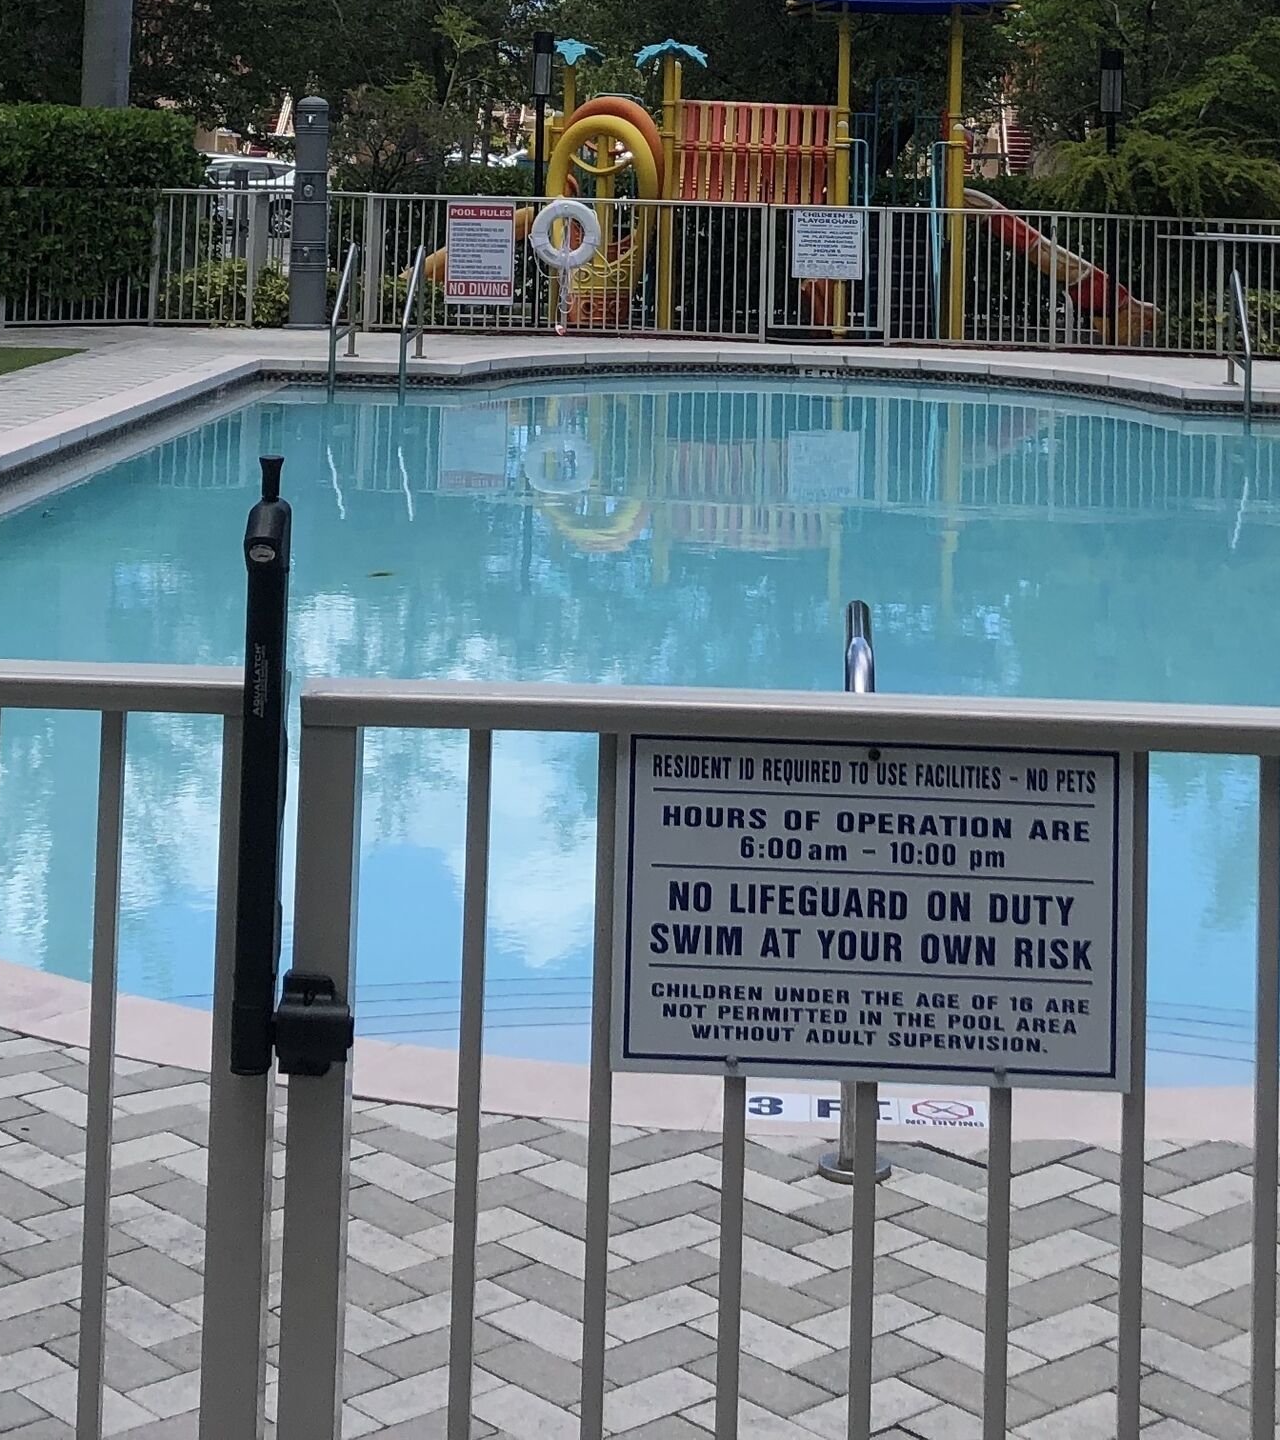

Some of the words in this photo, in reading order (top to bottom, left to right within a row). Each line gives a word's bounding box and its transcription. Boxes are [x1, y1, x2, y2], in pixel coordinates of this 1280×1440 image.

[451, 208, 476, 216] POOL
[480, 209, 512, 217] RULES
[449, 282, 465, 295] NO
[469, 283, 509, 296] DIVING
[652, 754, 732, 780] RESIDENT
[738, 757, 755, 781] ID
[762, 758, 842, 787] REQUIRED
[848, 761, 869, 785] TO
[876, 762, 908, 787] USE
[915, 763, 1002, 791] FACILITIES
[1026, 767, 1048, 792] NO
[1056, 769, 1096, 794] PETS
[662, 805, 767, 830] HOURS
[784, 809, 821, 832] OF
[836, 811, 1012, 839] OPERATION
[1028, 819, 1091, 843] ARE
[740, 835, 802, 861] 6:00
[808, 843, 848, 862] am
[889, 841, 956, 867] 10:00
[969, 849, 1005, 872] pm
[668, 880, 712, 913] NO
[729, 882, 908, 921] LIFEGUARD
[927, 890, 971, 923] ON
[988, 892, 1075, 927] DUTY
[649, 922, 743, 957] SWIM
[759, 927, 802, 959] AT
[816, 929, 902, 963] YOUR
[920, 933, 996, 968] OWN
[1013, 936, 1093, 972] RISK
[651, 982, 763, 1002] CHILDREN
[774, 986, 850, 1005] UNDER
[860, 989, 904, 1007] THE
[915, 991, 960, 1010] AGE
[971, 994, 999, 1011] OF
[1009, 996, 1033, 1013] 16
[1045, 997, 1090, 1016] ARE
[662, 1002, 708, 1020] NOT
[717, 1004, 848, 1025] PERMITTED
[859, 1009, 882, 1027] IN
[892, 1011, 936, 1030] THE
[947, 1013, 1006, 1033] POOL
[1015, 1016, 1077, 1035] AREA
[691, 1023, 795, 1043] WITHOUT
[805, 1028, 877, 1047] ADULT
[887, 1031, 1048, 1054] SUPERVISION.
[748, 1095, 784, 1116] 3
